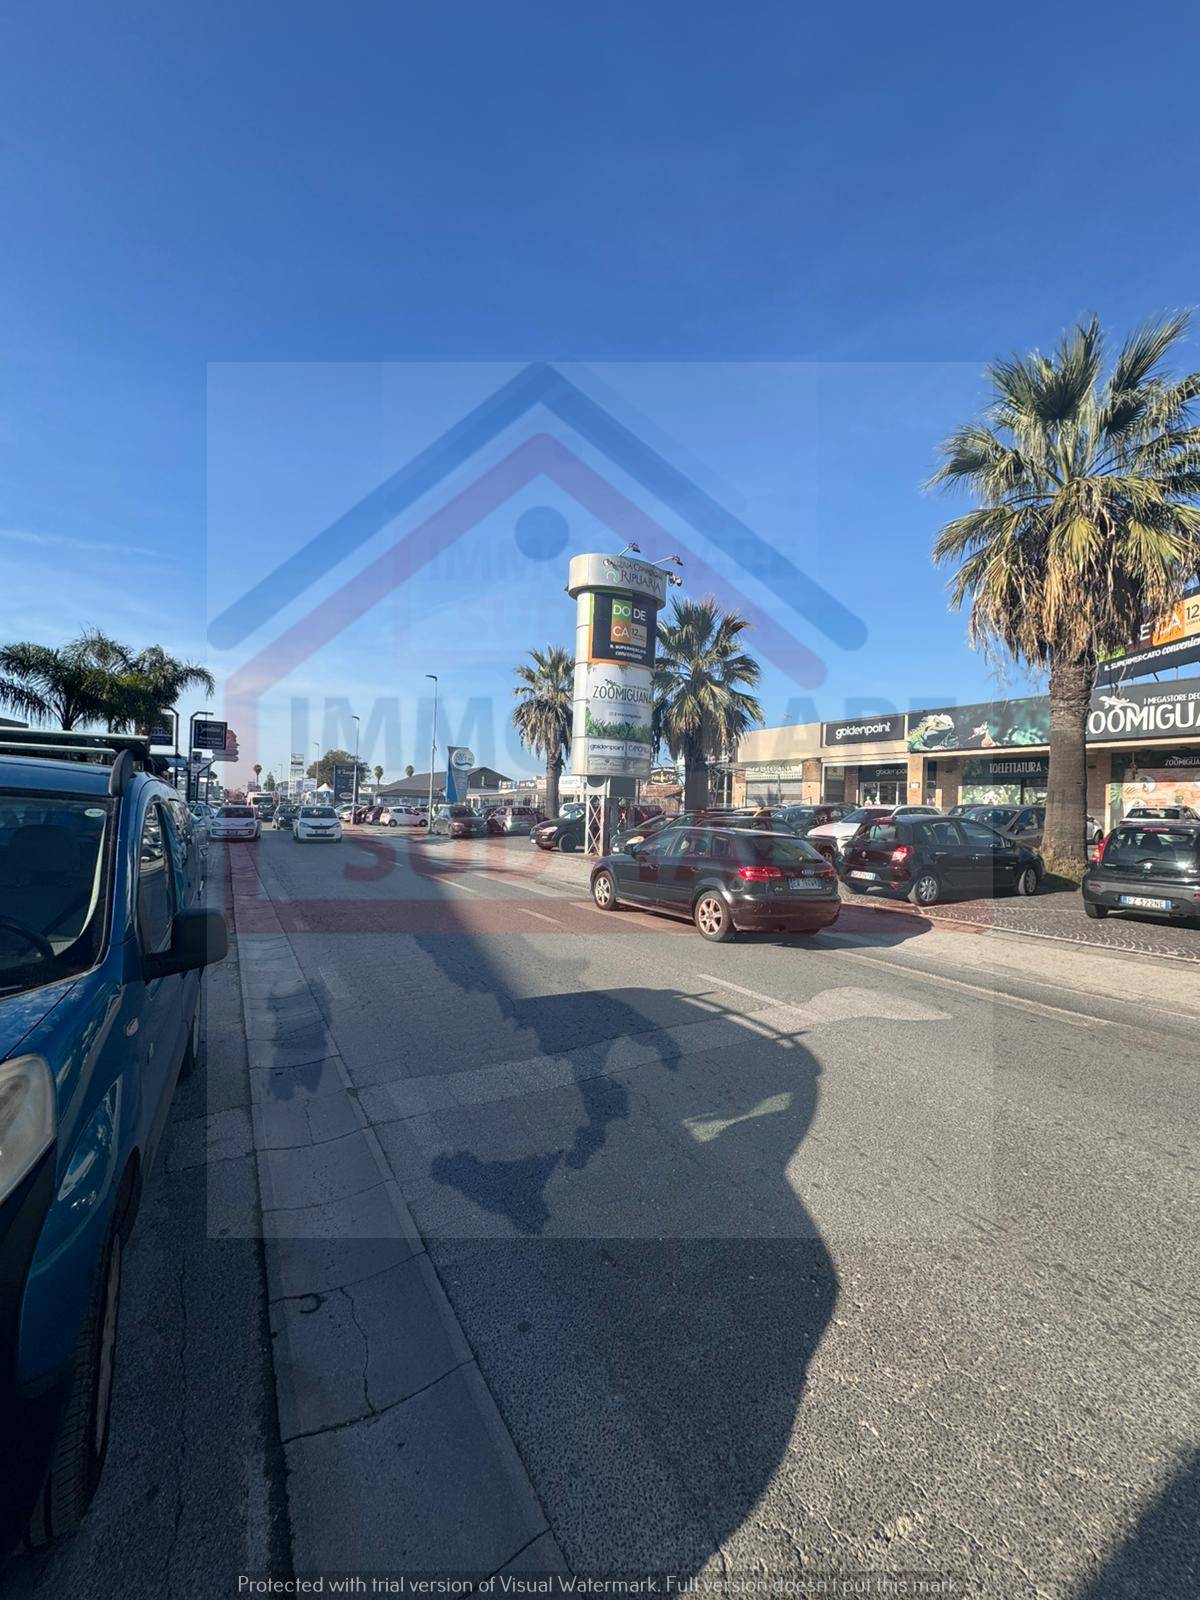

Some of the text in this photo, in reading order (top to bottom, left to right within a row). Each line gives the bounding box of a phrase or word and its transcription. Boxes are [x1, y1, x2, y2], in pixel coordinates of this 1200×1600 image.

[613, 604, 647, 621] DO DE
[613, 625, 630, 638] CA
[1111, 650, 1161, 670] SUPERMERCATO
[1147, 693, 1187, 704] MEGASTORE
[1085, 701, 1200, 735] OOMIGU
[835, 721, 891, 740] goldenpoint
